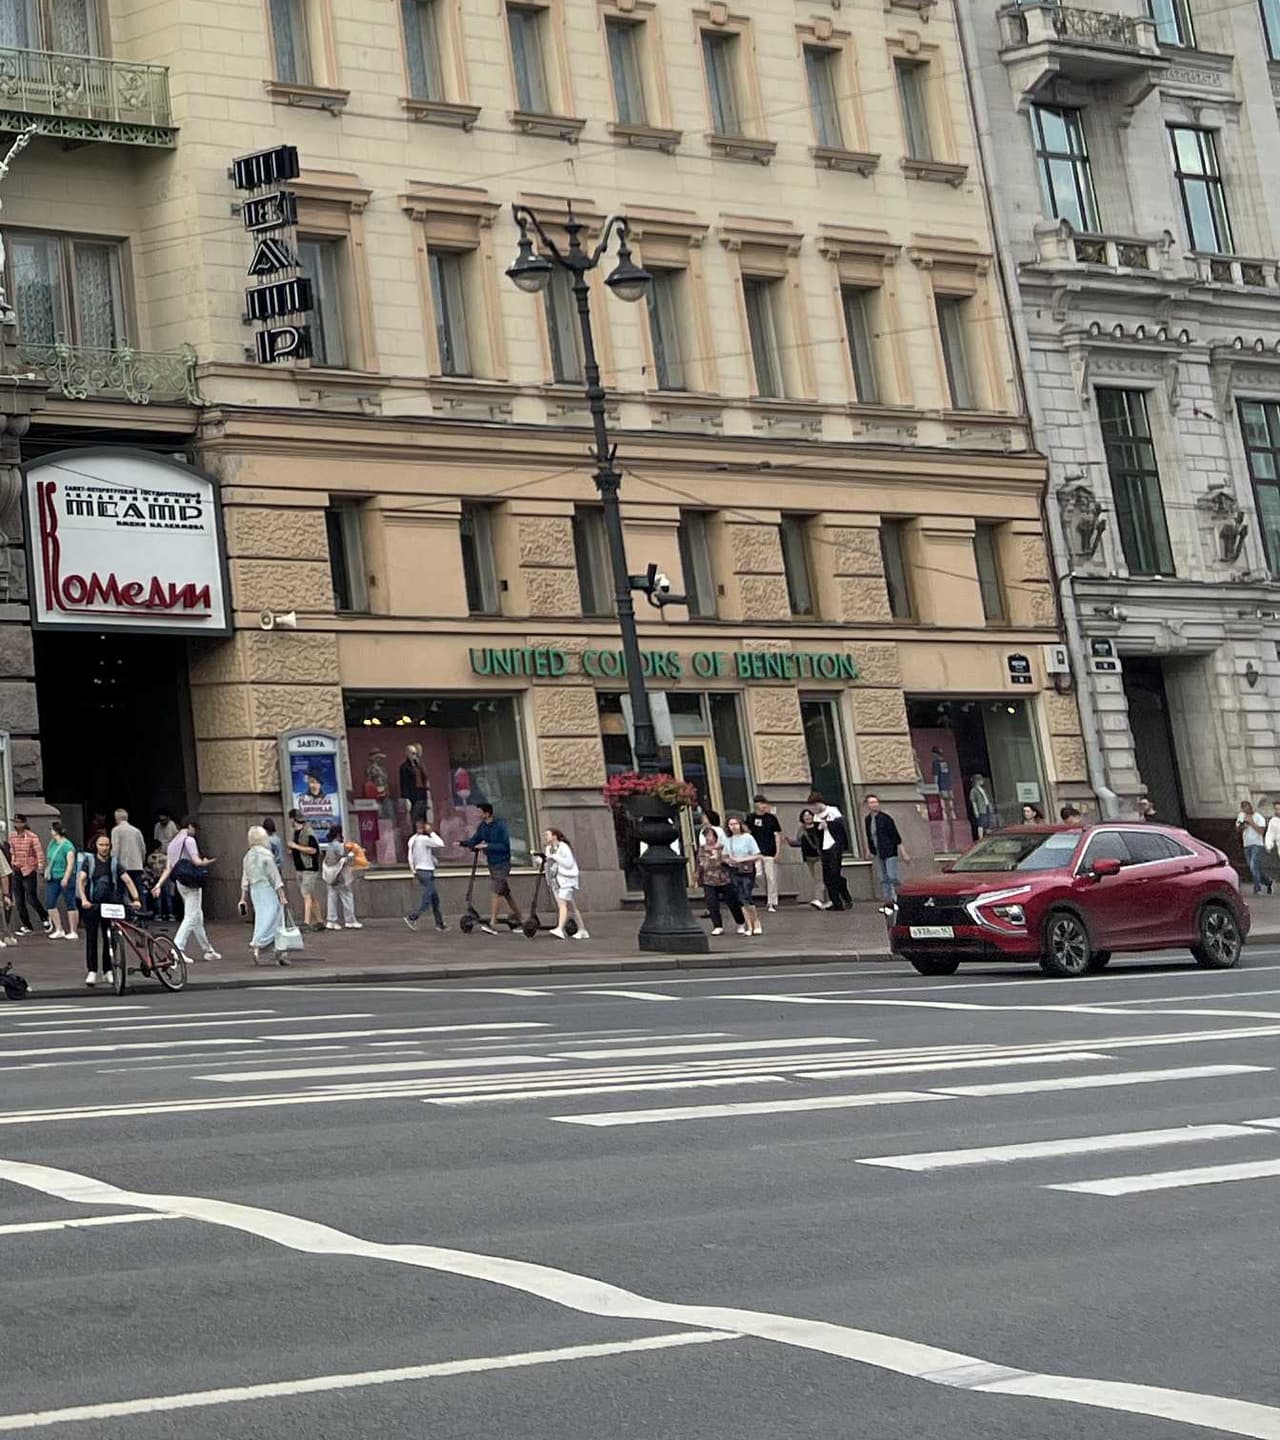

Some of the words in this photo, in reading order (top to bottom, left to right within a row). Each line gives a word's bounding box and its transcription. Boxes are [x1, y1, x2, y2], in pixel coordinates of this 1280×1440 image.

[469, 648, 568, 678] UNITED
[692, 651, 728, 678] OF
[735, 652, 858, 680] BENETTON
[297, 739, 325, 748] ЗАВТРА
